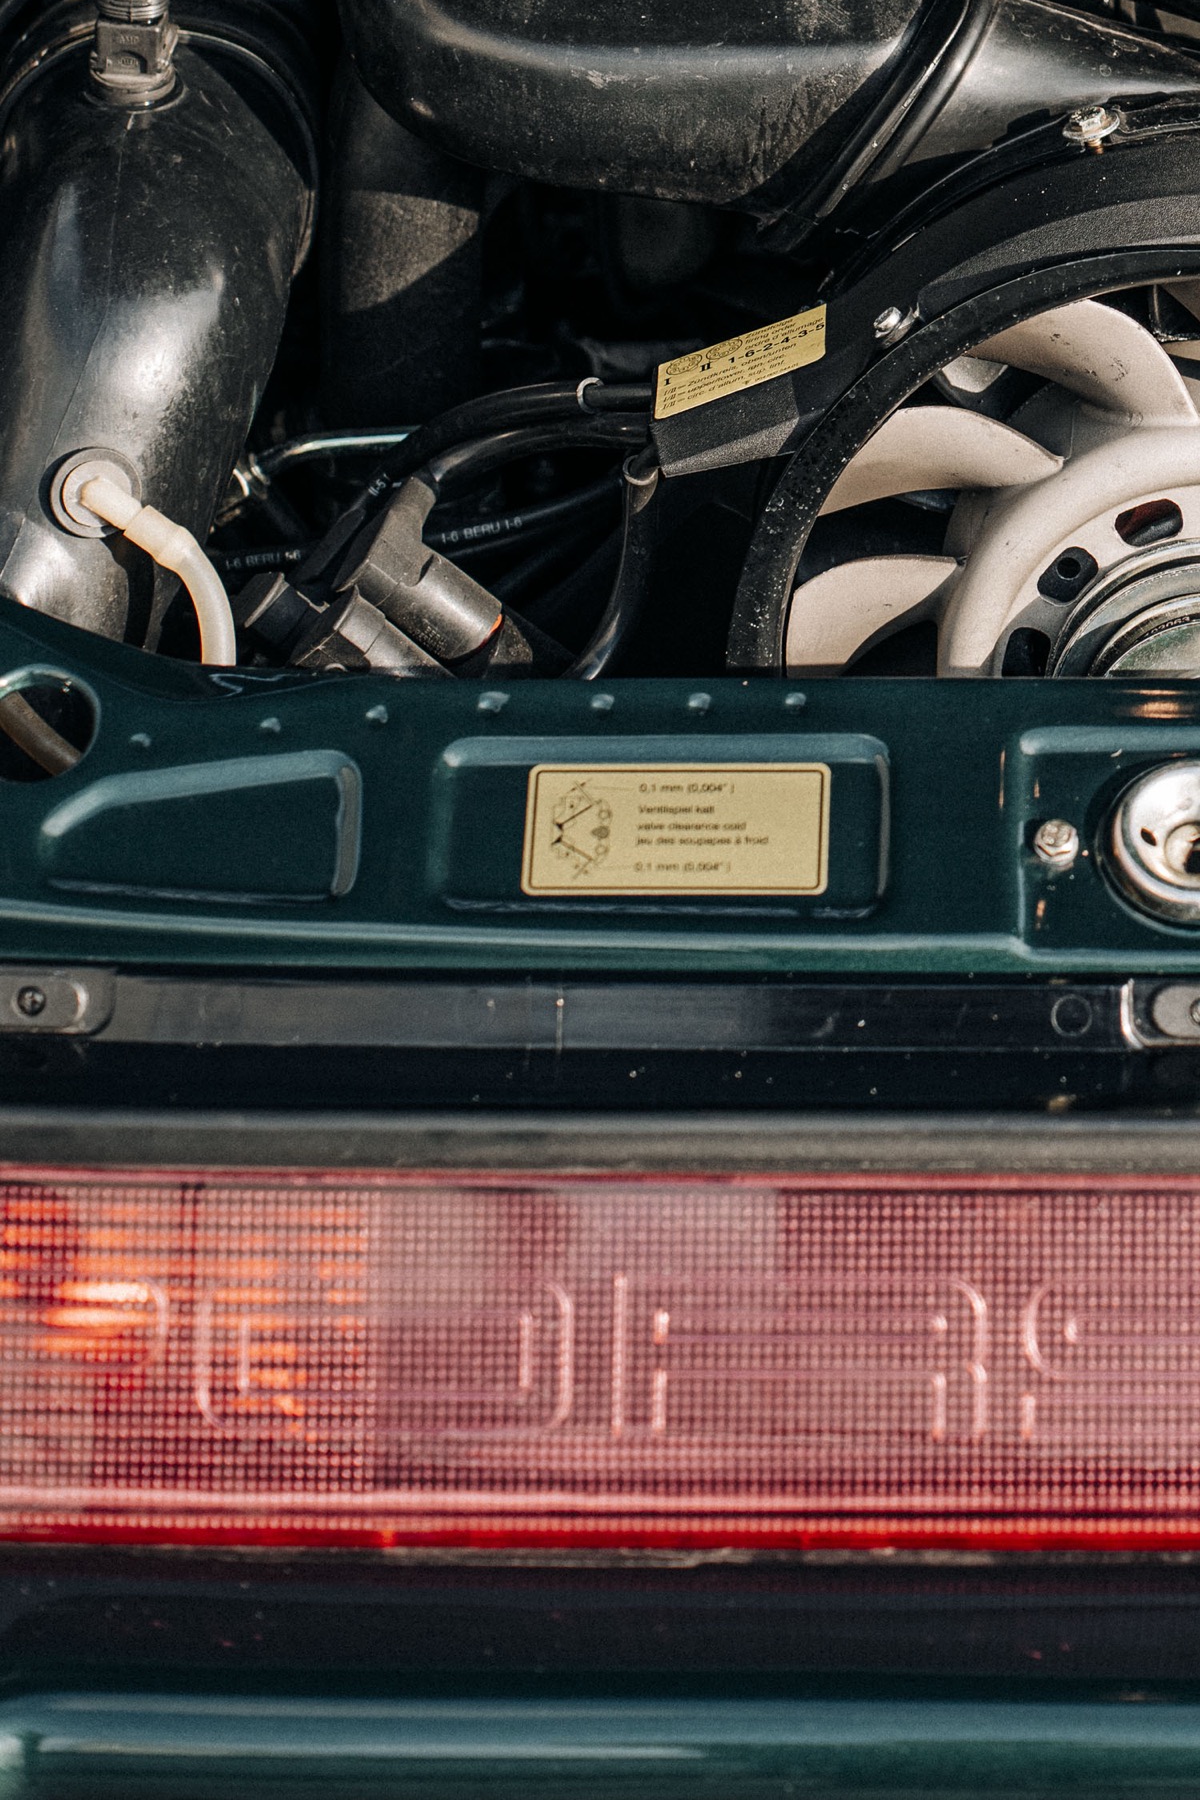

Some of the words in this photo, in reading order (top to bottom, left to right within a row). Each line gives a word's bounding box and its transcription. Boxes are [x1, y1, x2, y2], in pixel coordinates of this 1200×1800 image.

[745, 333, 769, 344] firing
[772, 322, 796, 334] order
[745, 338, 770, 350] ordre
[700, 362, 712, 372] II
[464, 524, 501, 540] BERU
[246, 554, 281, 567] BERU
[660, 784, 684, 792] mm
[638, 805, 692, 815] Ventilspiel
[695, 806, 715, 814] kalt
[668, 822, 719, 830] clearance
[723, 822, 746, 830] cold
[636, 837, 652, 846] jeu
[656, 836, 675, 844] des
[679, 838, 731, 846] soupapes
[745, 836, 769, 844] froid
[655, 863, 679, 871] mm
